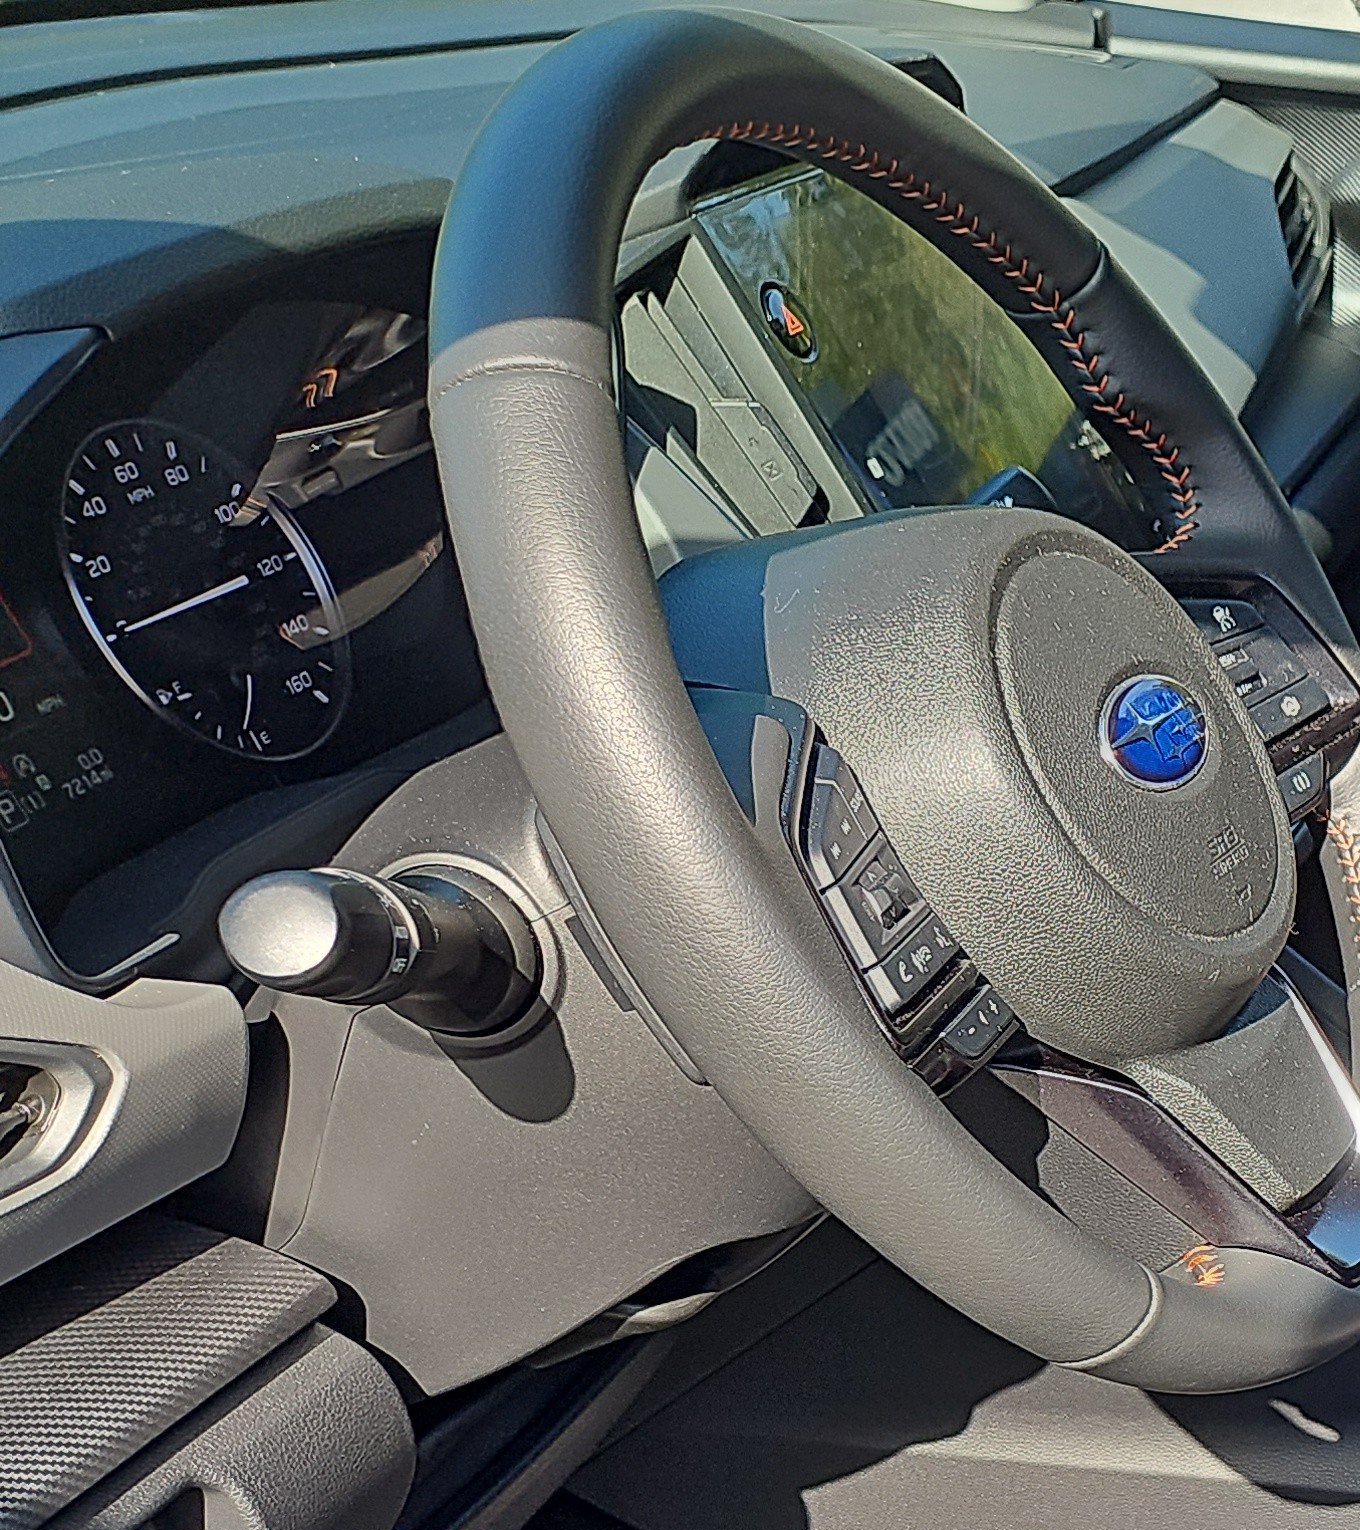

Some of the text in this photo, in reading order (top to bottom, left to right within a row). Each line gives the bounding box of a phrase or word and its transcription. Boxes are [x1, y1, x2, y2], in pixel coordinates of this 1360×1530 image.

[113, 461, 139, 484] 60
[164, 464, 190, 486] 80
[126, 485, 155, 505] MPH
[82, 496, 107, 518] 40
[214, 501, 240, 524] 100
[85, 555, 111, 578] 20
[256, 554, 283, 577] 120
[281, 614, 309, 637] 140
[171, 680, 182, 694] F
[285, 670, 313, 695] 160
[259, 730, 272, 745] E
